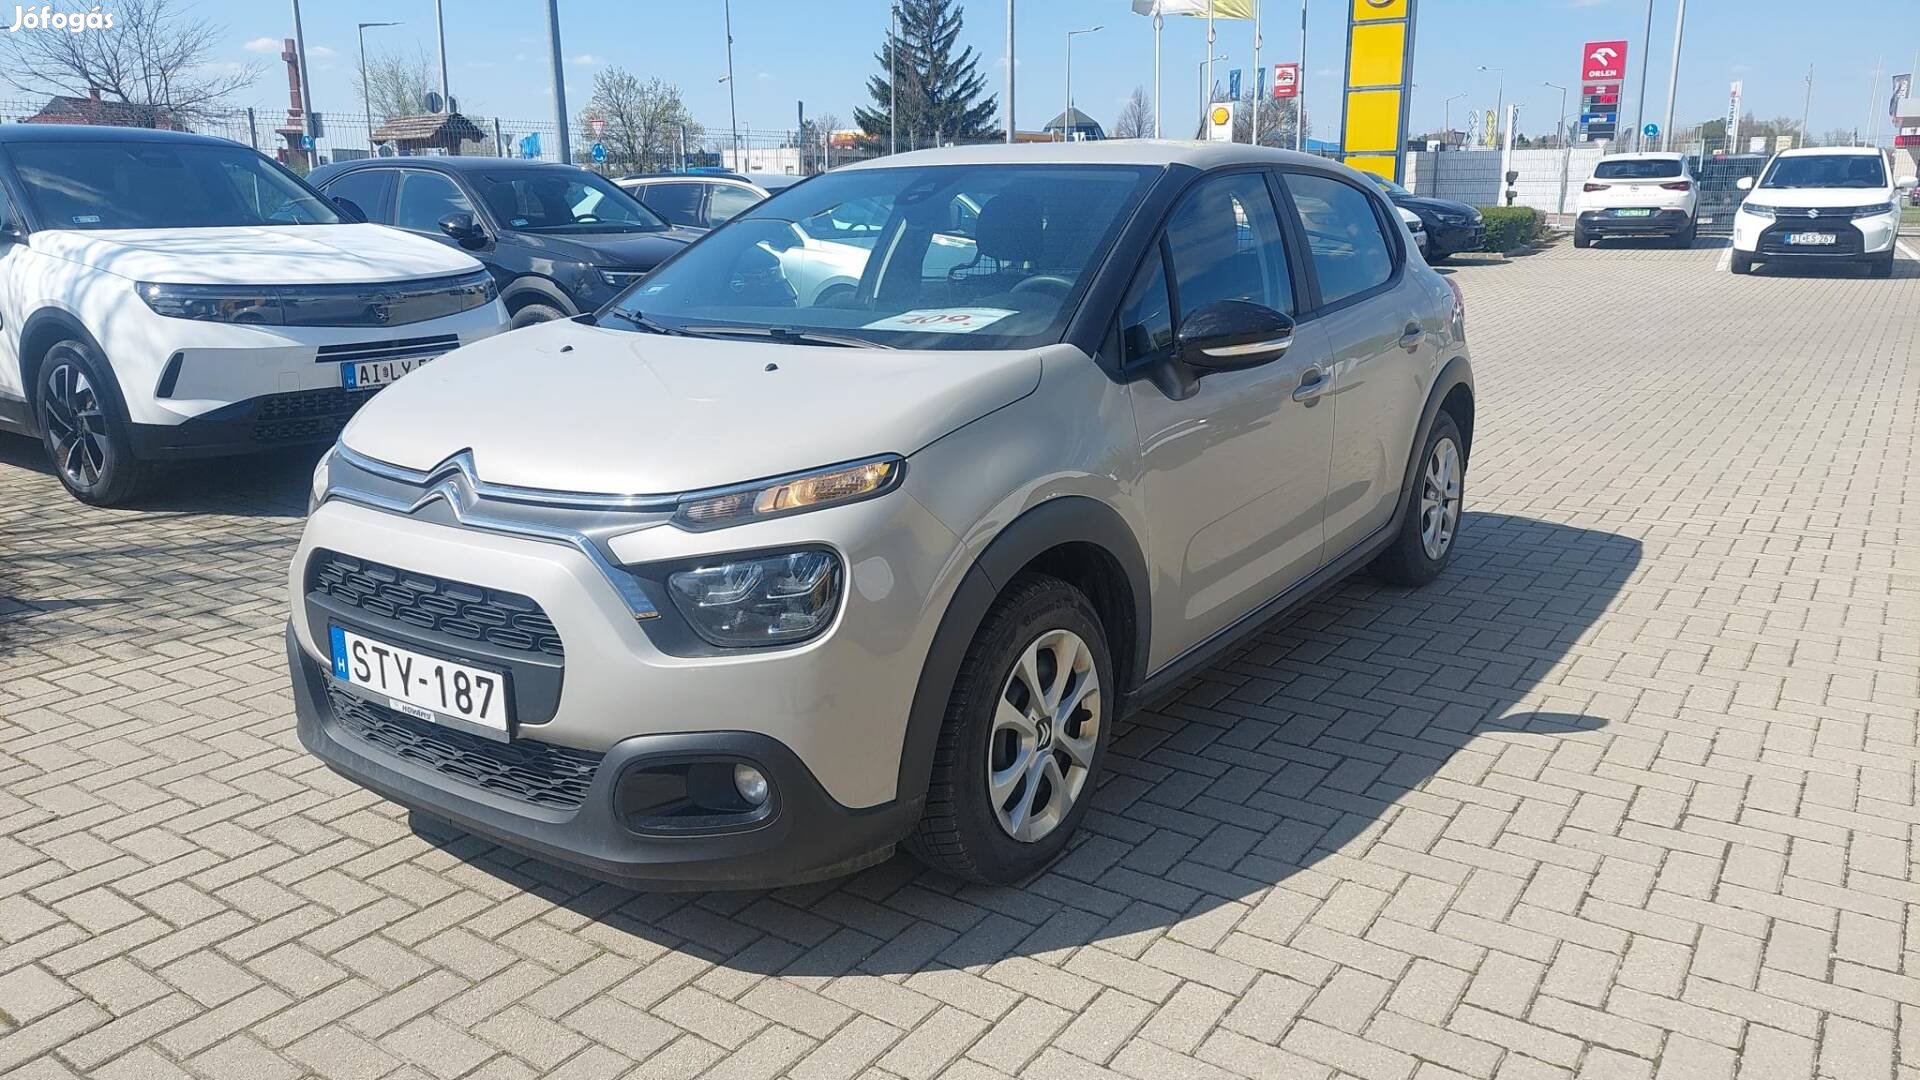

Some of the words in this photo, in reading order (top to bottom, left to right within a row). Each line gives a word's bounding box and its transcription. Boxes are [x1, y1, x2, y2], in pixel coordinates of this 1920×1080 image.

[1588, 69, 1617, 78] ORLEN
[337, 657, 346, 673] H
[352, 640, 494, 719] STY-187
